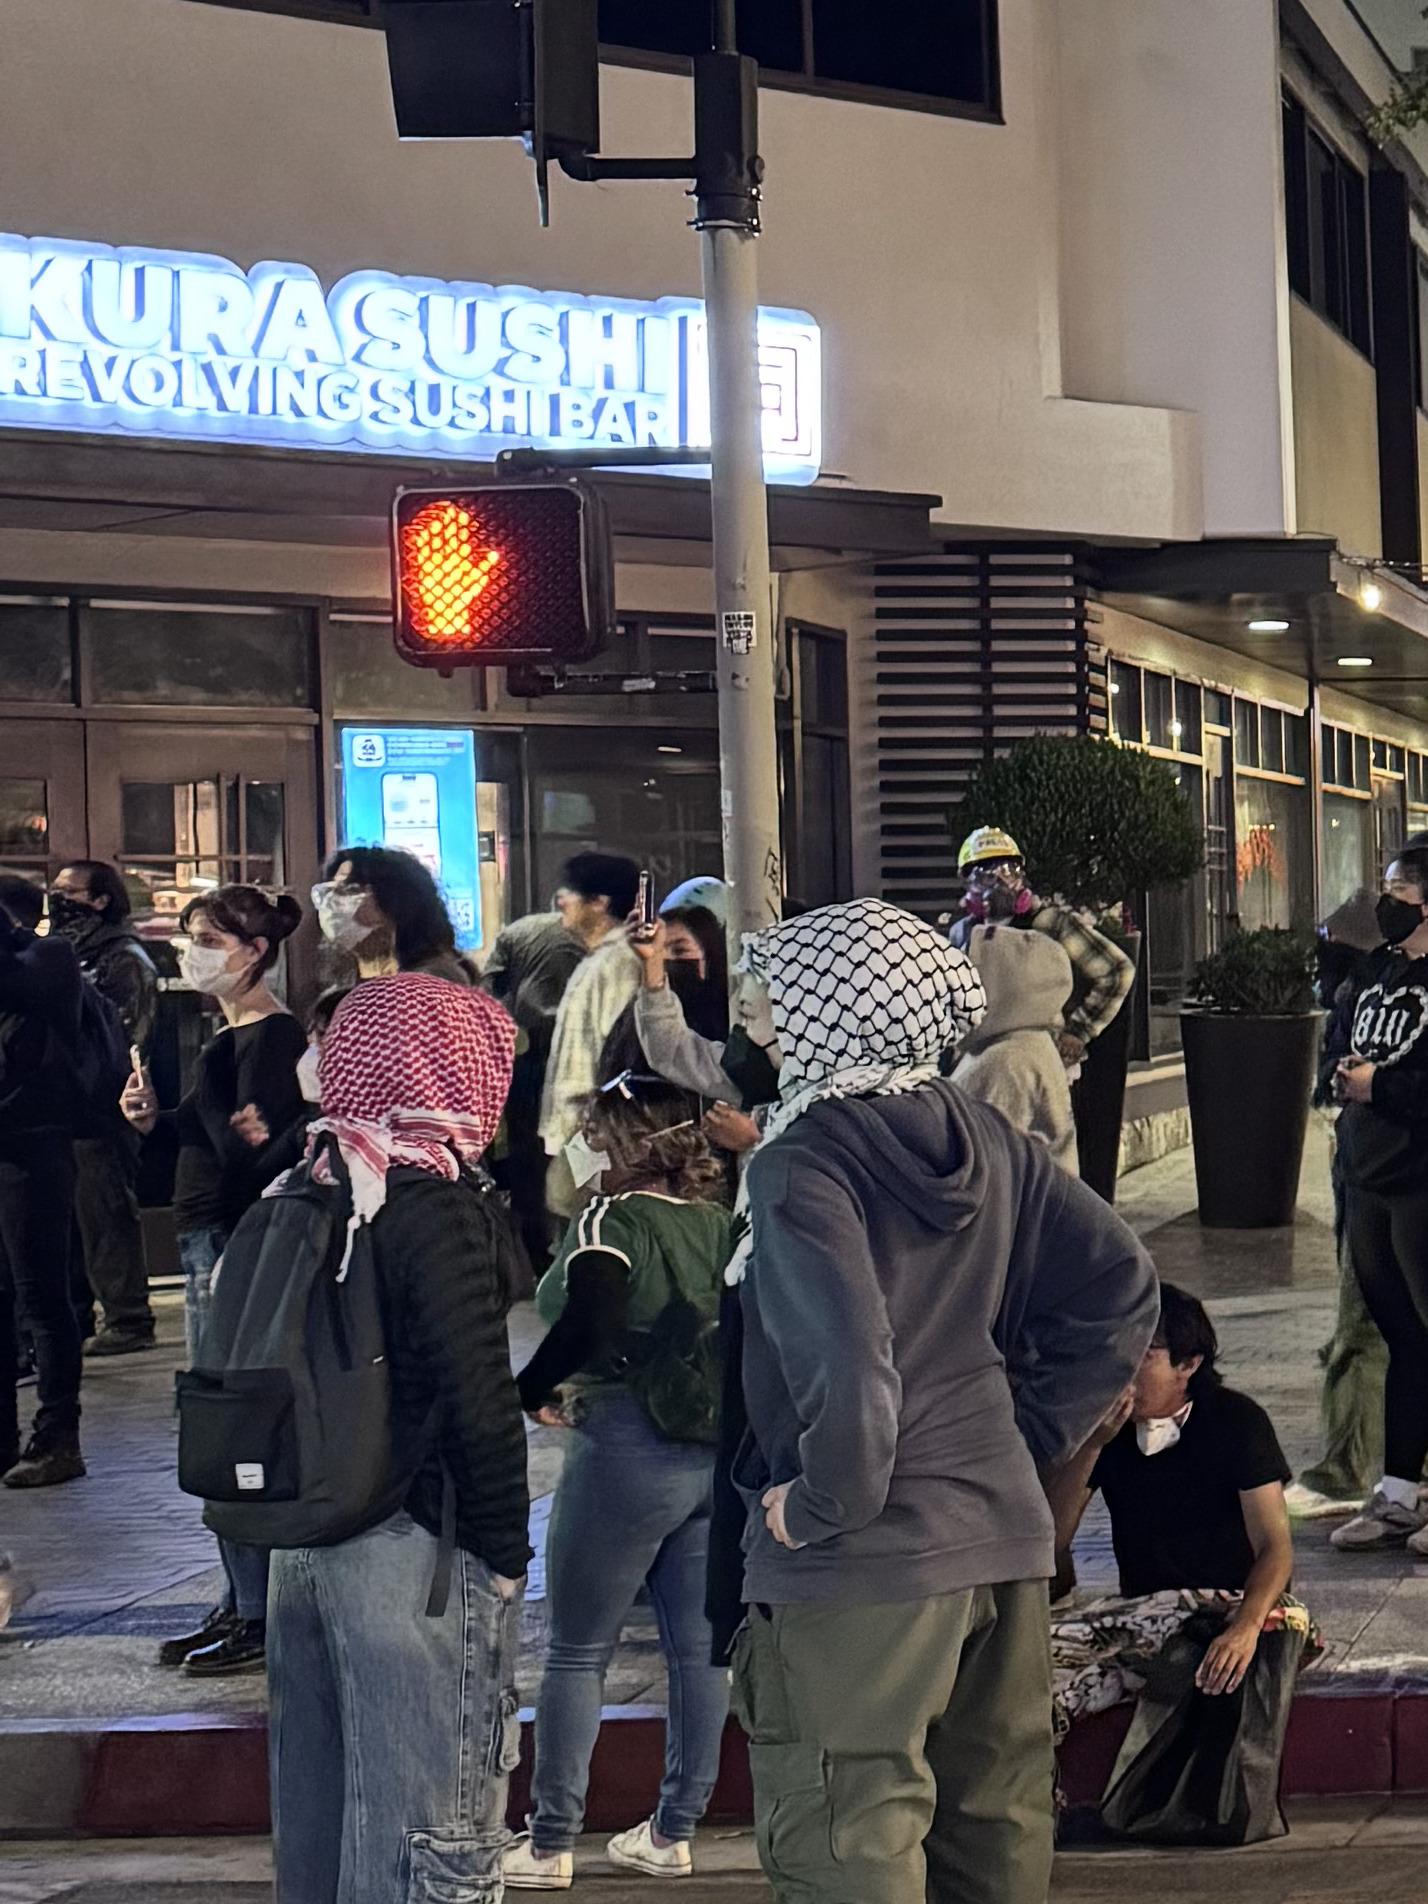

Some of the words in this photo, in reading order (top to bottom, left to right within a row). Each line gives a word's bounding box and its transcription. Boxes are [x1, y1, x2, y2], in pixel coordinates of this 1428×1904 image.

[0, 251, 347, 366] KURA
[353, 286, 672, 395] SUSHI
[0, 346, 362, 424] REVOLVING
[366, 377, 545, 437] SUSHI
[560, 391, 671, 447] BAR
